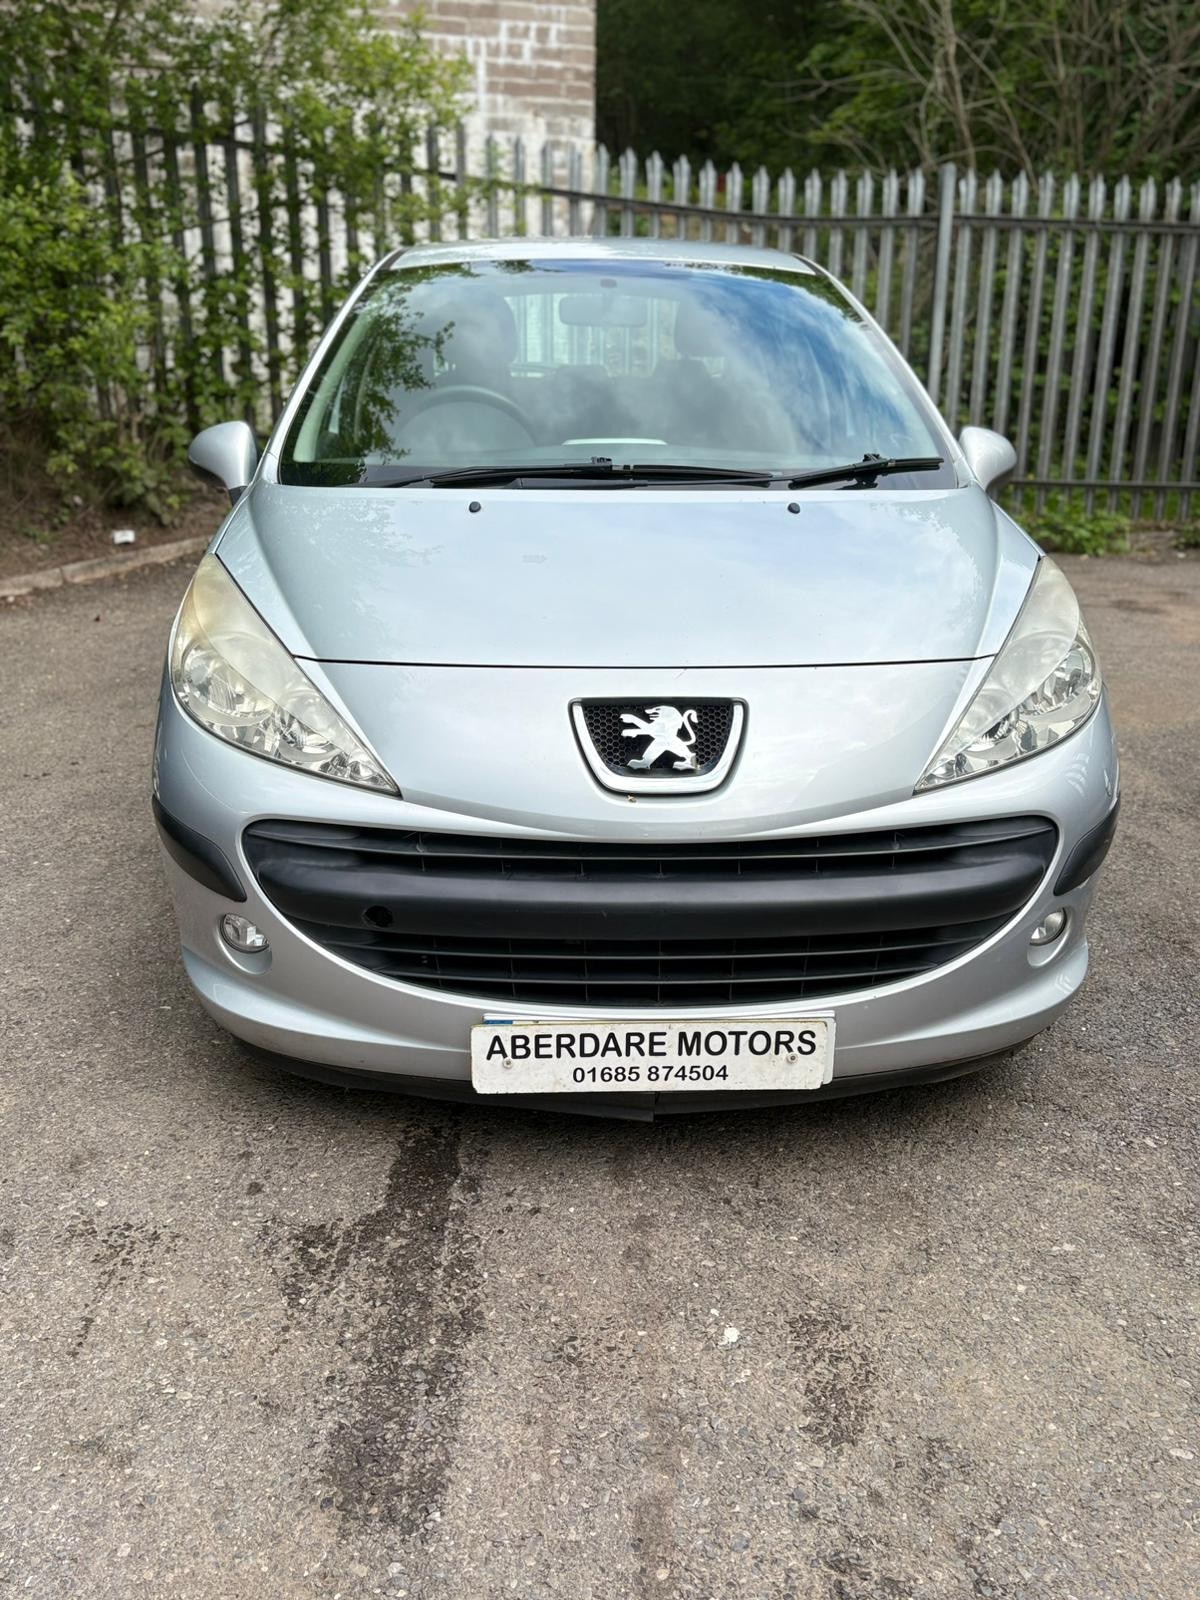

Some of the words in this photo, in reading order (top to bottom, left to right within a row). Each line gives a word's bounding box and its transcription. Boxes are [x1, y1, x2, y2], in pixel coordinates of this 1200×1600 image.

[486, 1032, 667, 1061] ABERDARE
[677, 1030, 816, 1057] MOTORS
[572, 1066, 640, 1083] 01685
[647, 1065, 729, 1082] 874504
